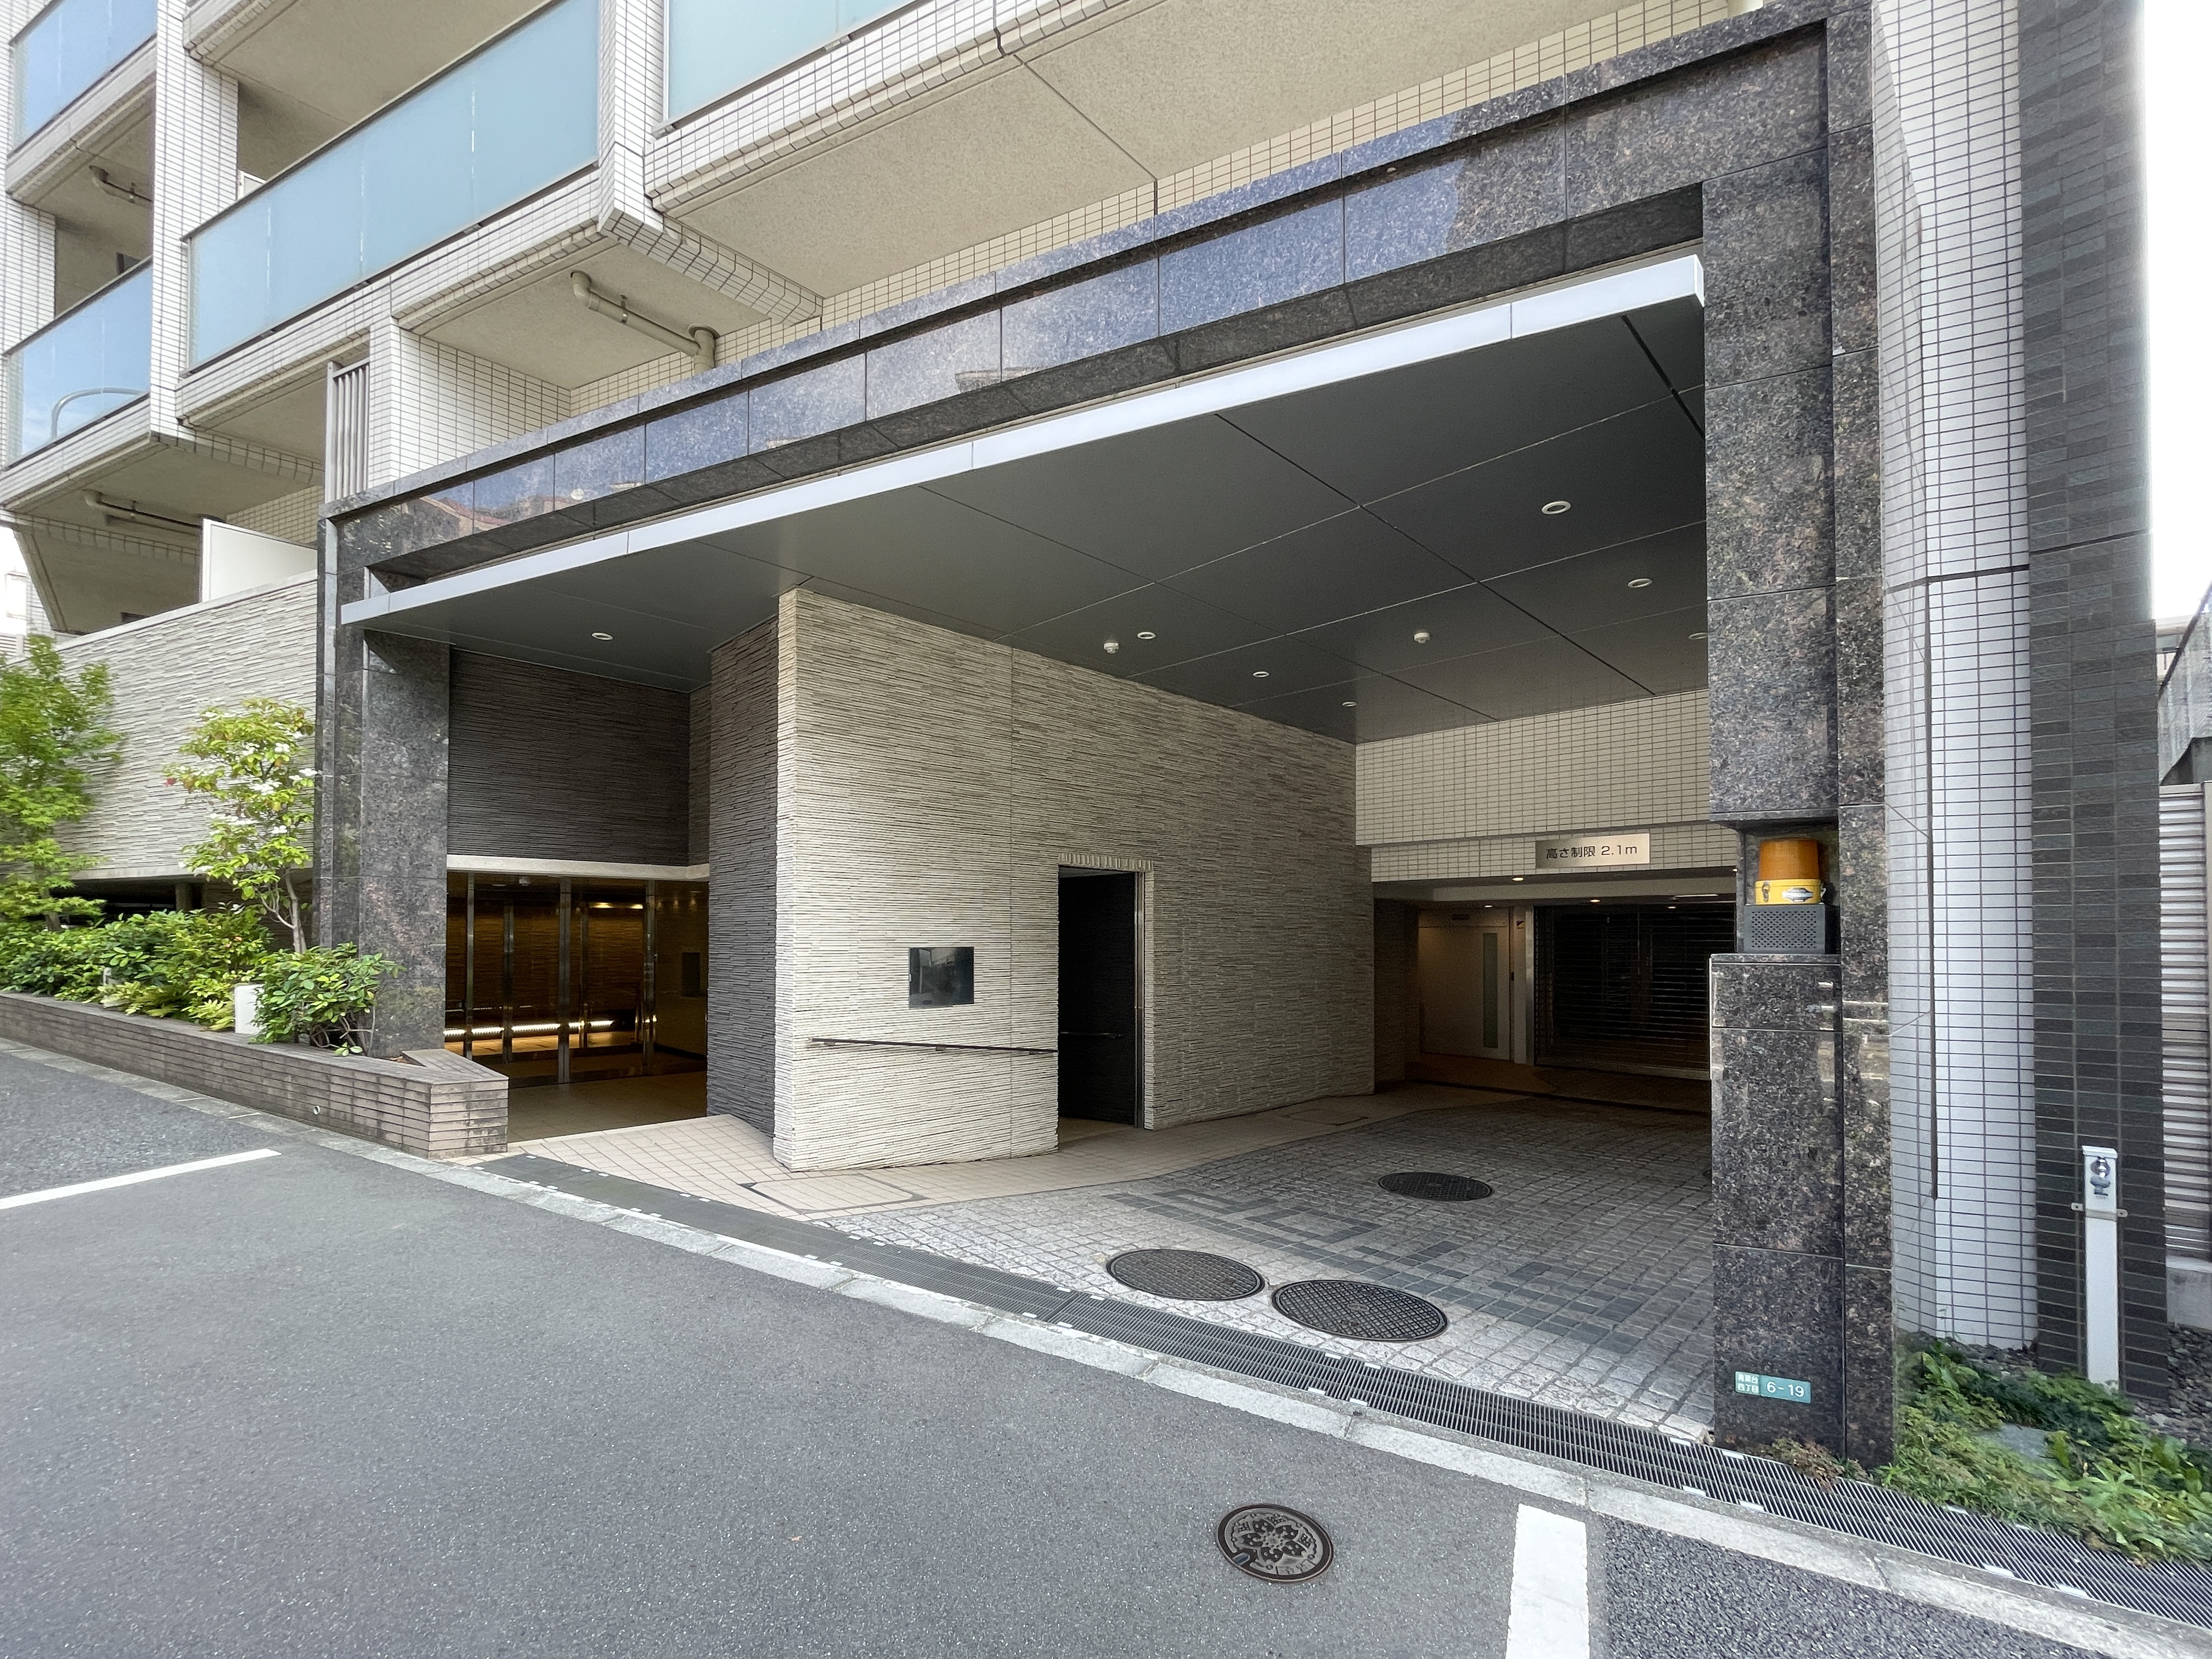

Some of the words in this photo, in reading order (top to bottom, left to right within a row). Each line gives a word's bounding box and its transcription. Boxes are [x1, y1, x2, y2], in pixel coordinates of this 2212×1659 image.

[1546, 845, 1596, 860] 高さ制限
[1601, 845, 1638, 855] 2.1m
